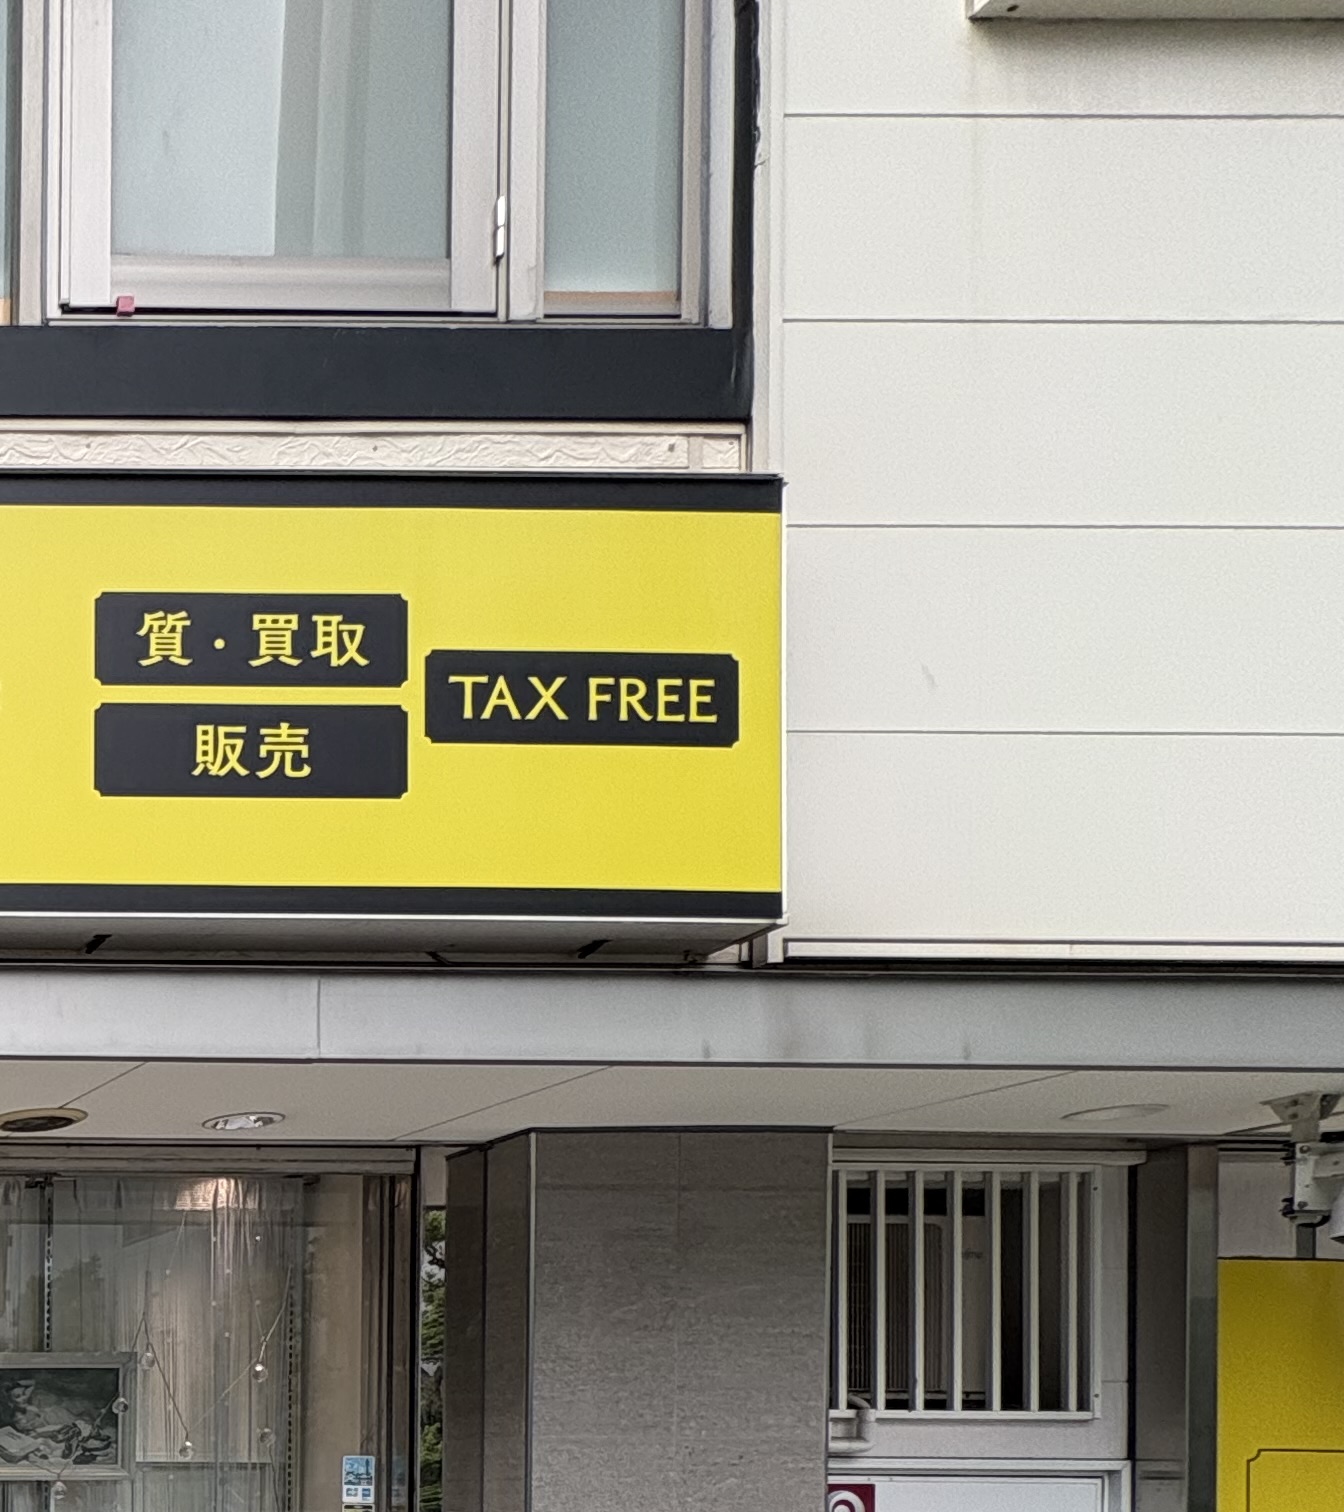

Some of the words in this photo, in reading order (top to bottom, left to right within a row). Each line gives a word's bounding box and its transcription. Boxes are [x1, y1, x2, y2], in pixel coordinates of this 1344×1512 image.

[136, 610, 370, 668] 質・買取
[448, 675, 568, 721] TAX
[586, 677, 718, 723] FREE
[191, 722, 312, 777] 販売
